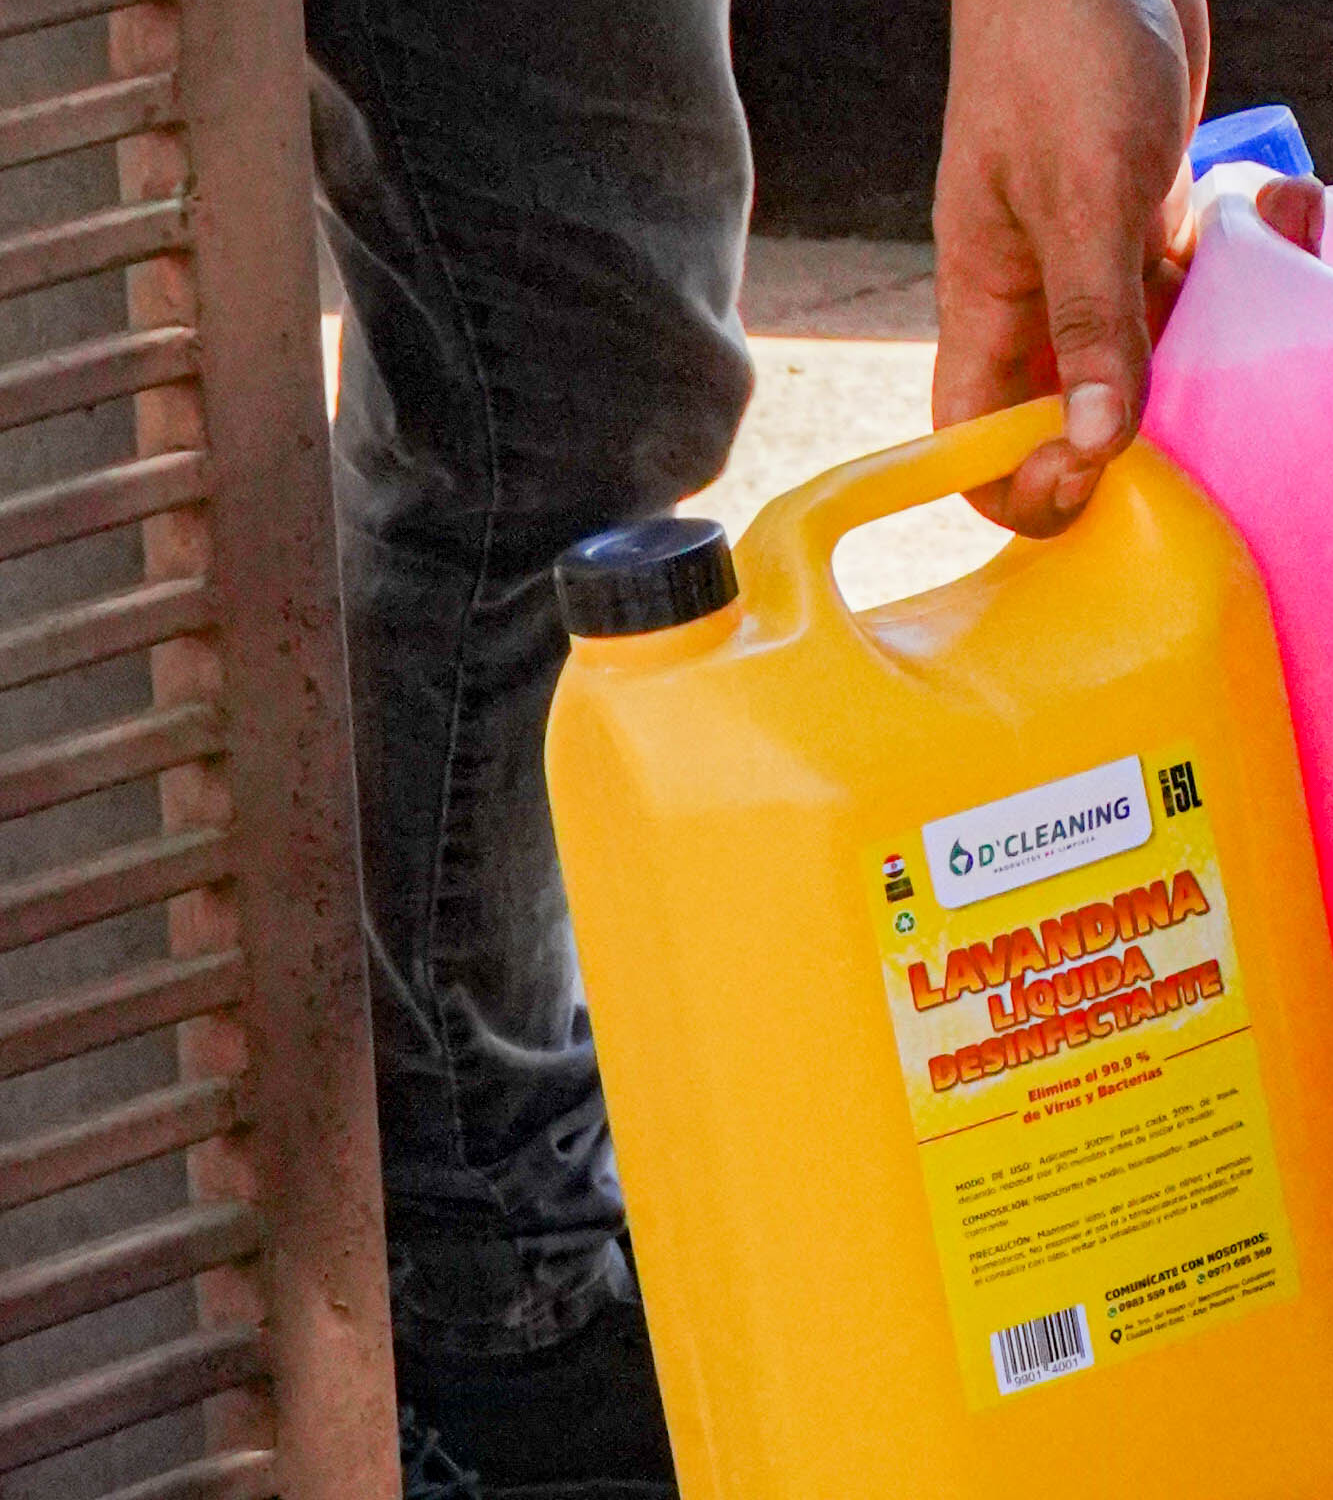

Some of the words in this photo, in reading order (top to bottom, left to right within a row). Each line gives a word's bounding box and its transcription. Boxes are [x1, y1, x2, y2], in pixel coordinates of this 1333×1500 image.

[978, 797, 1131, 868] D'CLEANING
[908, 869, 1210, 1012] LAVANDINA
[988, 945, 1154, 1033] LÍQUIDA
[928, 958, 1225, 1093] DESINFECTANTE
[1023, 1111, 1041, 1124] de
[1044, 1097, 1083, 1116] Virus
[1085, 1091, 1094, 1105] y
[1097, 1066, 1162, 1099] Bacterias
[1028, 1078, 1081, 1103] Elimina
[1084, 1072, 1098, 1083] el
[1105, 1266, 1178, 1301] COMUNÍCATE
[1181, 1257, 1204, 1273] CON
[1207, 1232, 1269, 1262] NOSOTROS:
